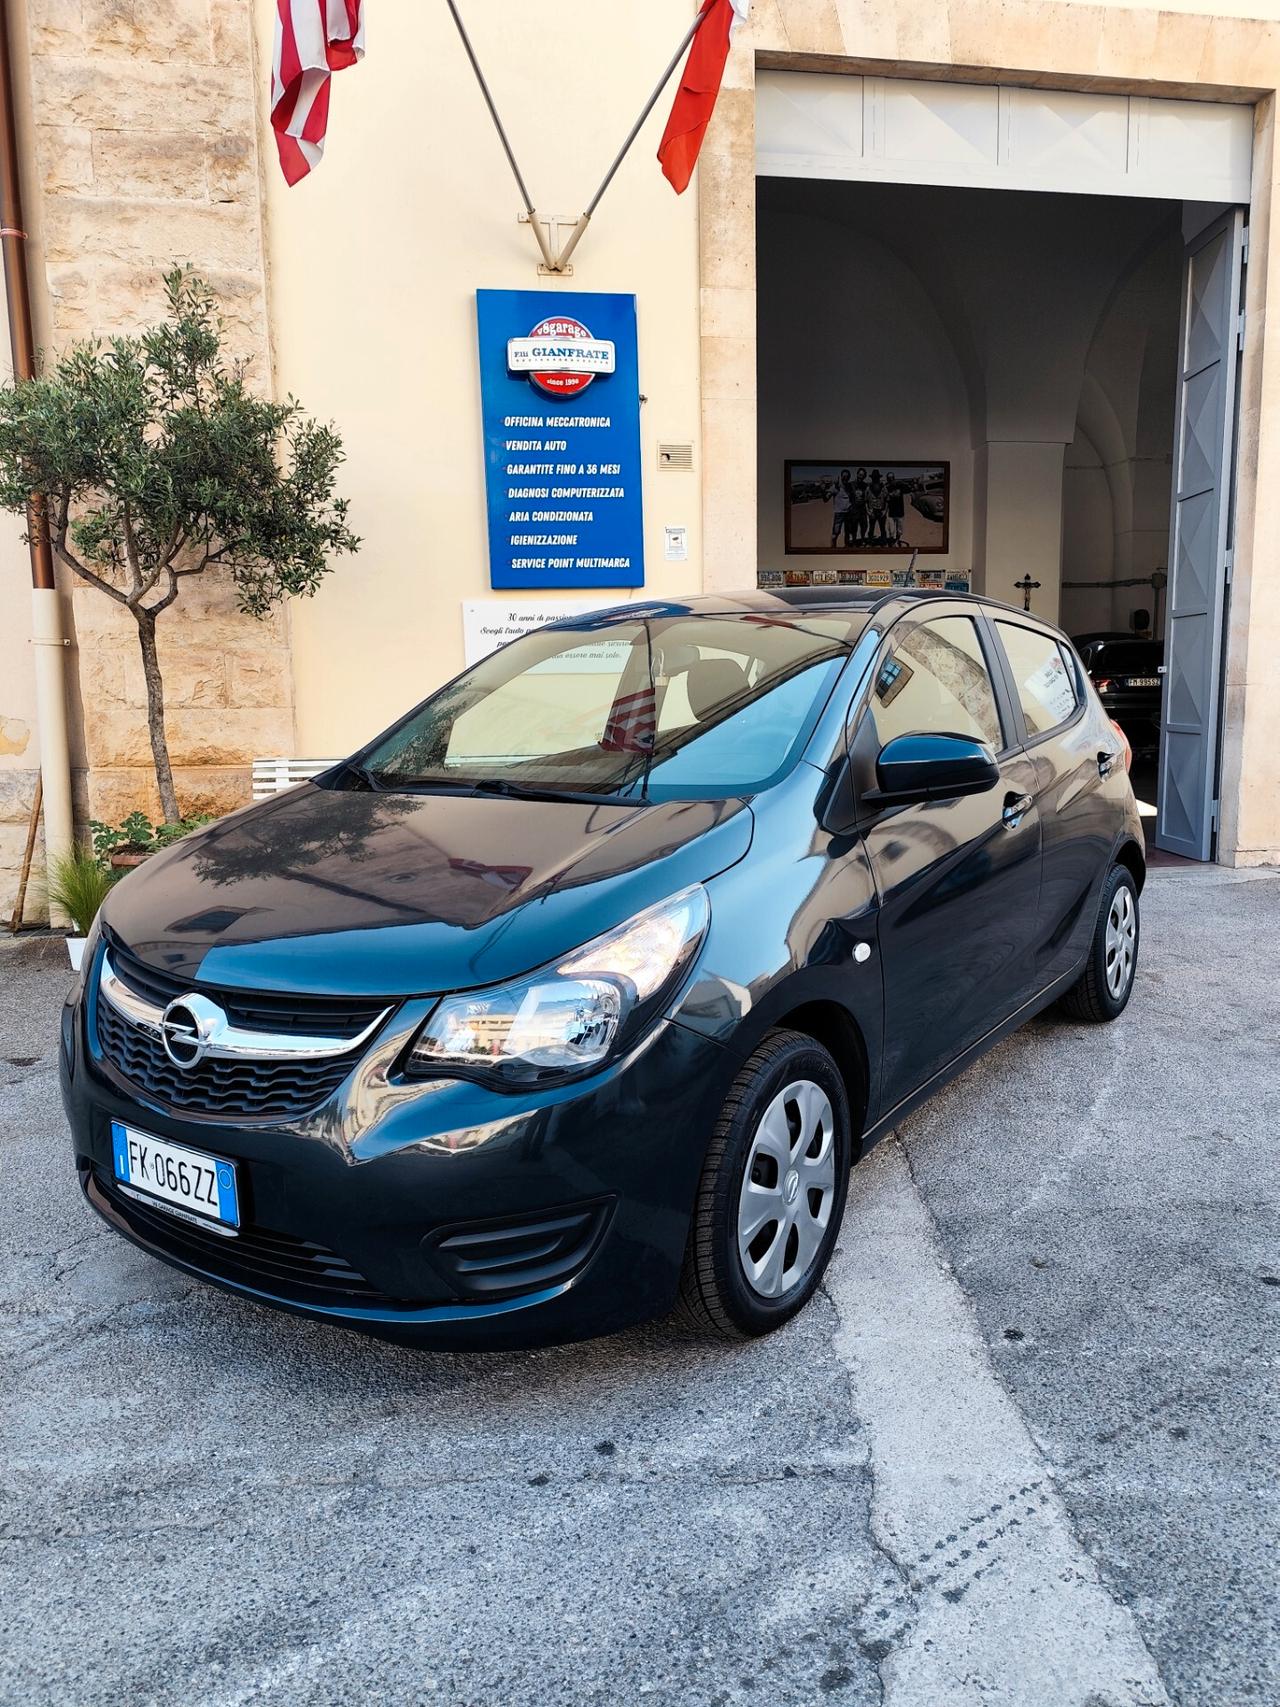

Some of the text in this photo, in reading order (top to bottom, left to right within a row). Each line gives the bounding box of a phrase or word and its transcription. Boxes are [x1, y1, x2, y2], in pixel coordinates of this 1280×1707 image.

[532, 347, 609, 360] GIANFRATE
[504, 416, 611, 428] OFFICINA MECCATRONICA
[505, 440, 567, 451] VENDITA AUTO
[507, 464, 621, 475] GARANTITE FINO A 36 MESI
[508, 487, 625, 498] DIAGNOSI COMPUTERIZZATA
[509, 511, 594, 522] ARIA CONDIZIONATA
[510, 535, 578, 546] IGIENIZZAZIONE
[511, 557, 631, 569] SERVICE POINT MULTIMARCA
[507, 613, 518, 622] 30
[536, 613, 544, 621] di
[545, 614, 573, 622] passion
[480, 626, 504, 635] Scegli
[588, 651, 605, 659] mai
[129, 1141, 150, 1181] FK
[154, 1153, 218, 1207] 066ZZ
